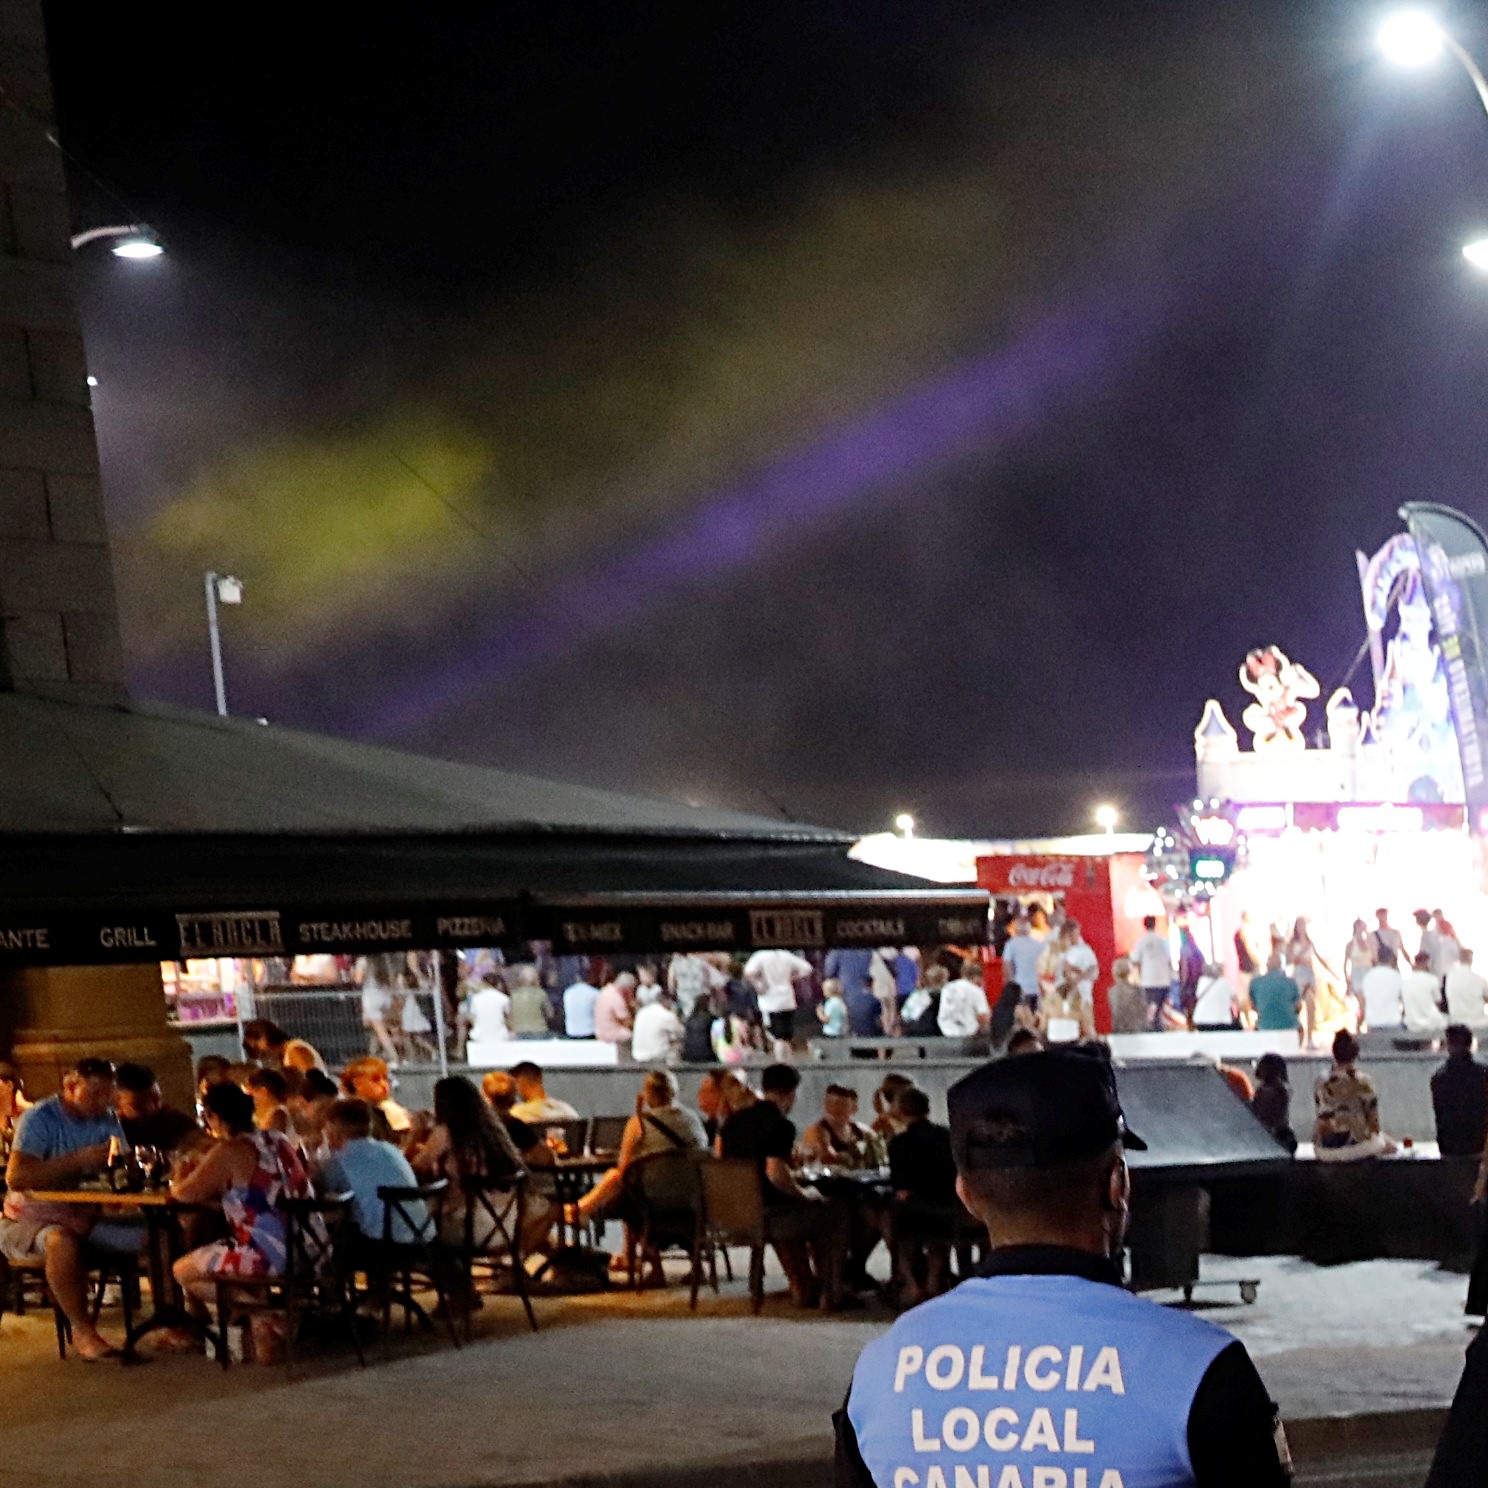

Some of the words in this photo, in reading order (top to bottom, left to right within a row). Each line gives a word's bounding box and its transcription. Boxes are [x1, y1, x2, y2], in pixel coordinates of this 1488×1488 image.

[100, 927, 157, 947] GRILL
[893, 1344, 1125, 1395] POLICIA
[911, 1406, 1095, 1454] LOCAL
